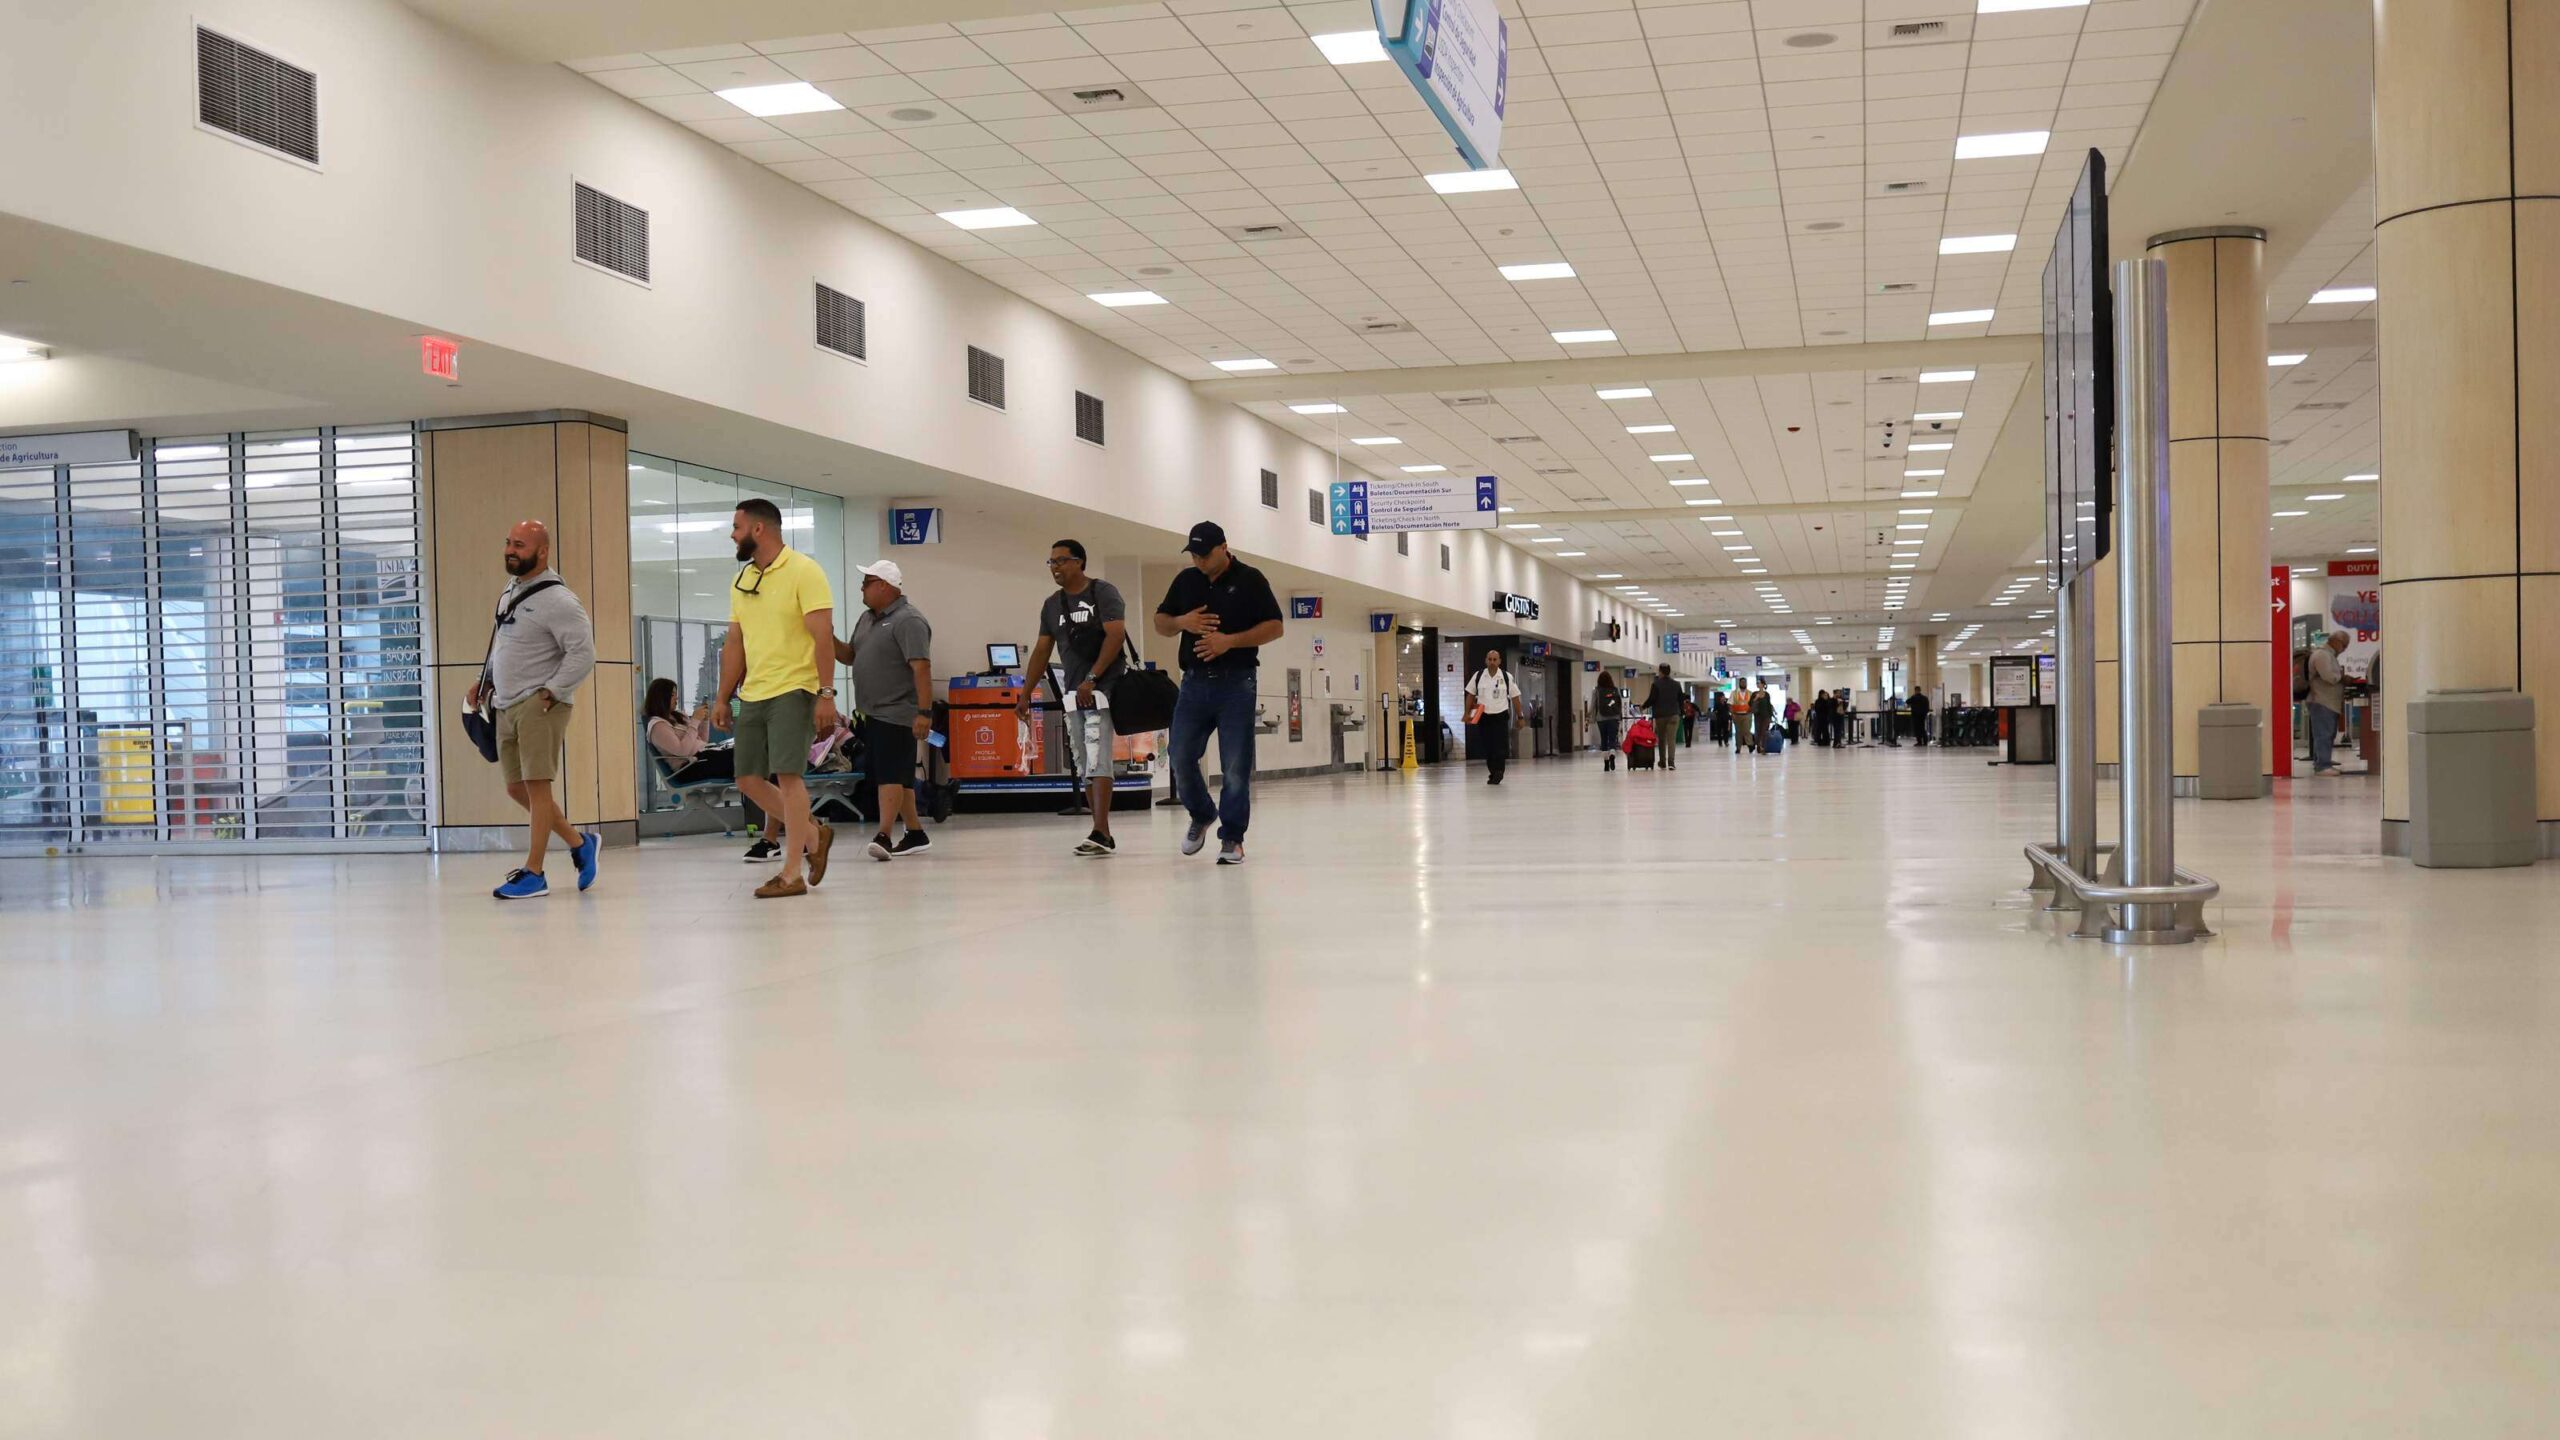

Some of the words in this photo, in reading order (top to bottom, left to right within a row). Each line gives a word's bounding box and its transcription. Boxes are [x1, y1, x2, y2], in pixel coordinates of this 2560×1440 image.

[431, 342, 452, 374] EXIT
[12, 451, 59, 463] Agricultura
[1402, 505, 1433, 513] Seguridad
[2347, 564, 2371, 572] DUTY
[2357, 591, 2379, 603] YE
[2357, 630, 2379, 642] BU
